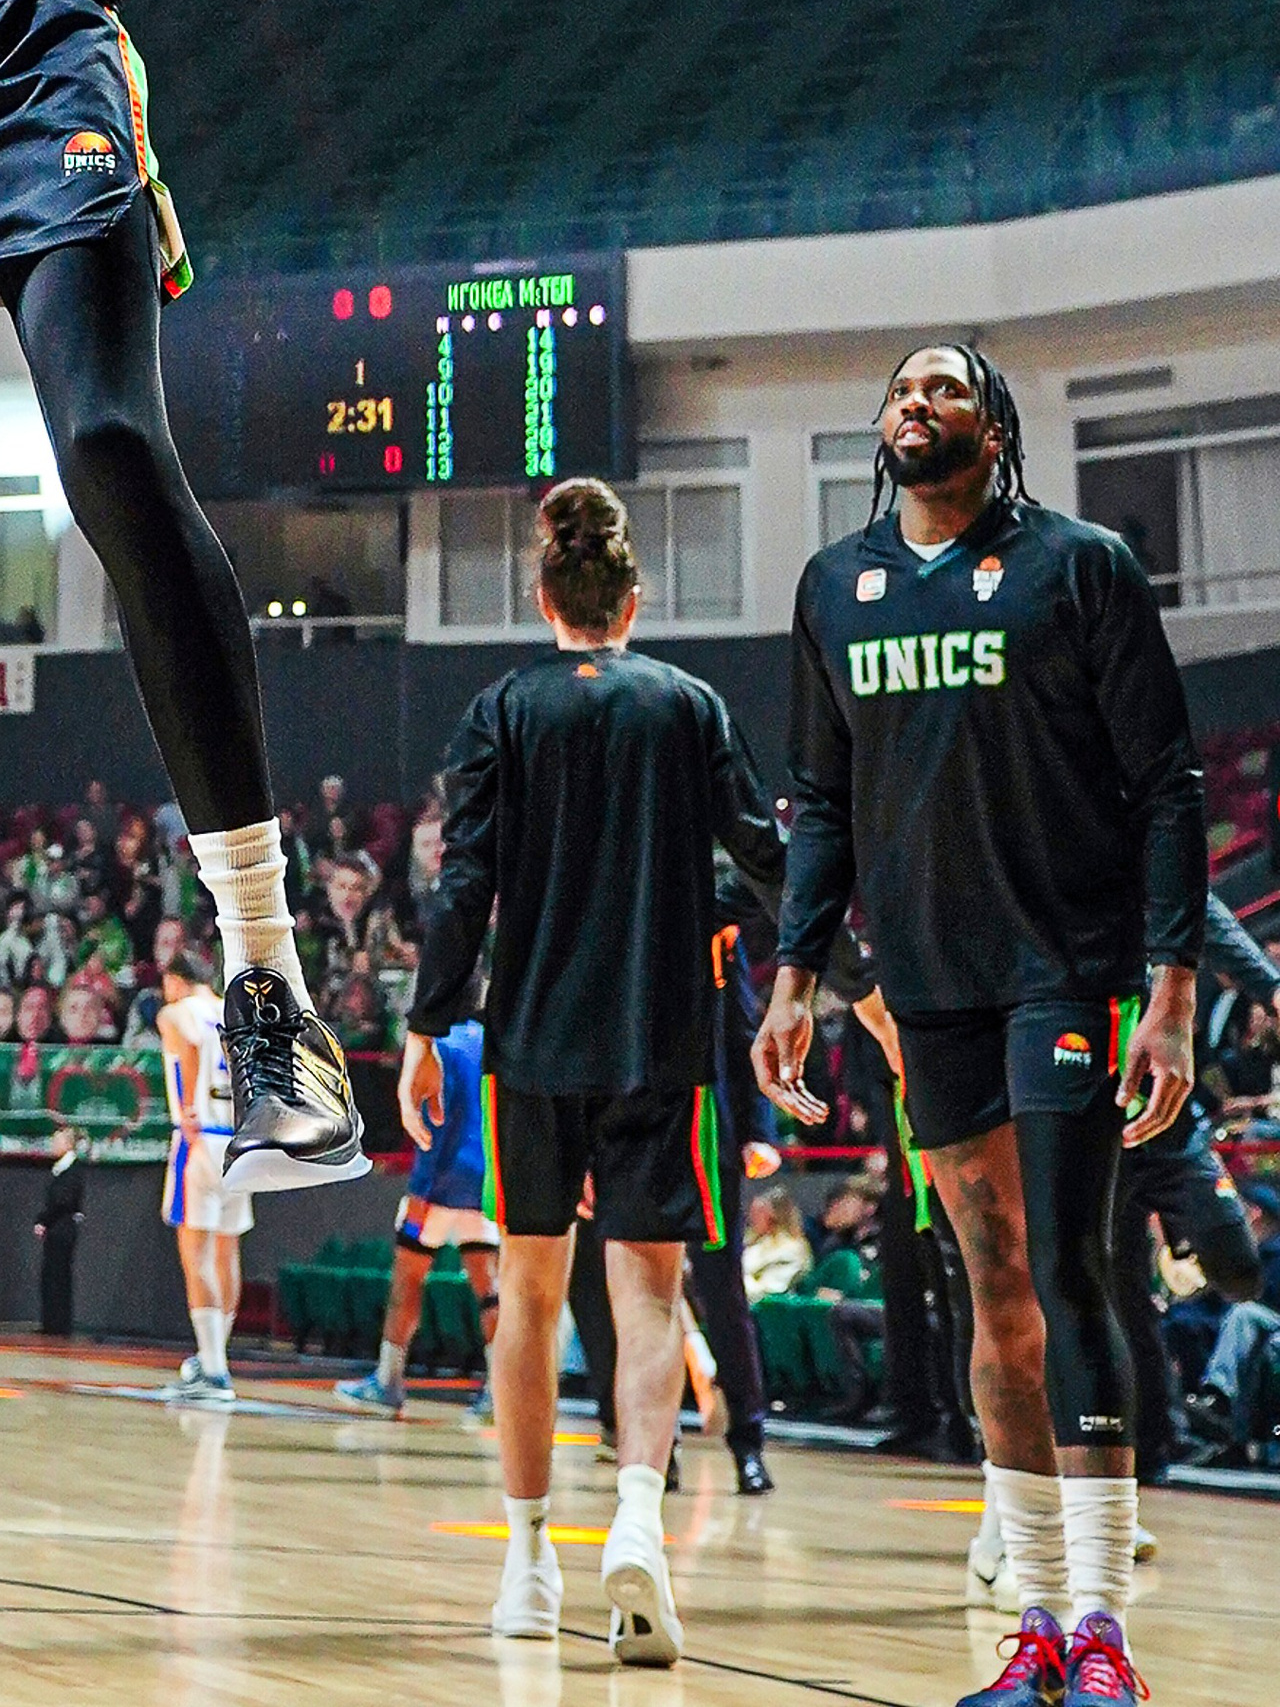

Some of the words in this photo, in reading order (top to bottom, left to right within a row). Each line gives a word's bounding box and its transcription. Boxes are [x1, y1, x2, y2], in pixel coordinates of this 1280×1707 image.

[64, 154, 116, 169] UNICS
[327, 398, 394, 434] 2:31
[848, 630, 1006, 696] UNICS
